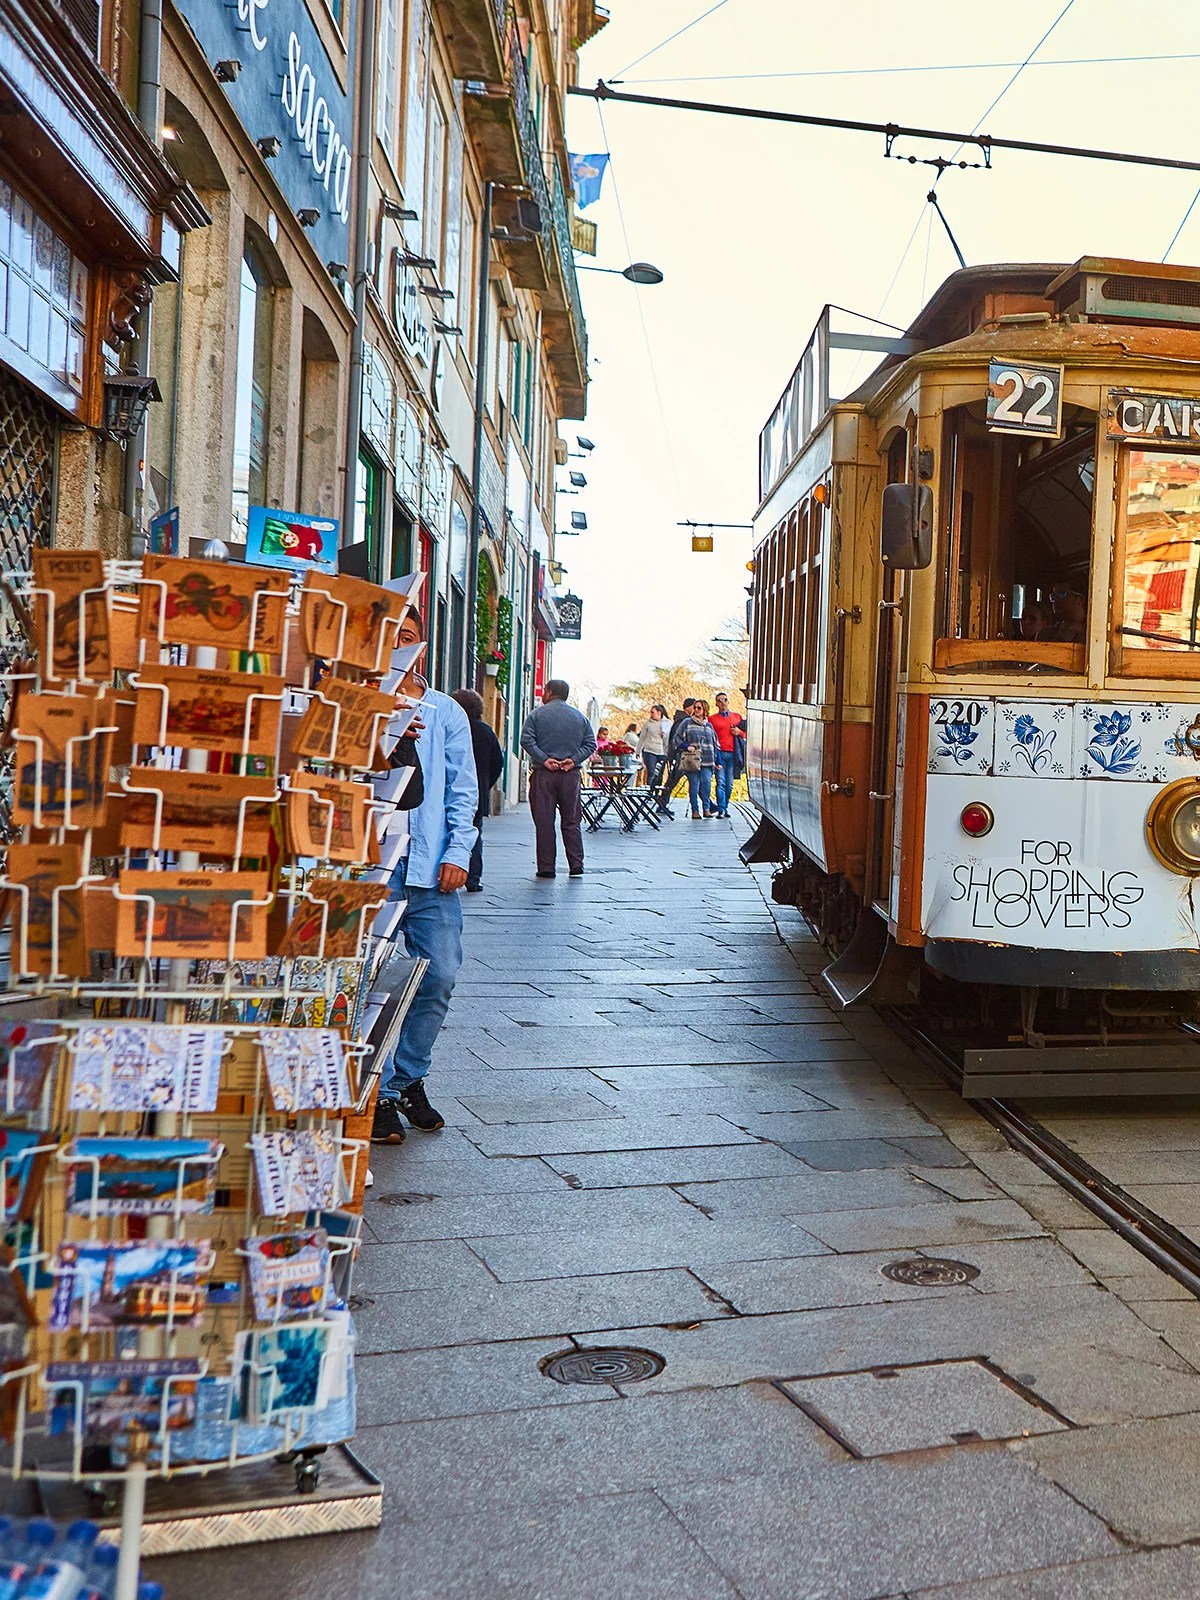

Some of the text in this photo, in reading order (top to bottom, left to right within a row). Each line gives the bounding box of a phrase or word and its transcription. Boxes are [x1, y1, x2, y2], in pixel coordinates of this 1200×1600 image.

[993, 371, 1053, 426] 22
[934, 701, 982, 727] 220
[1021, 840, 1072, 866] FOR
[950, 865, 1144, 905] SHOPPING
[972, 891, 1132, 928] LOVERS
[108, 1200, 173, 1211] PORTO
